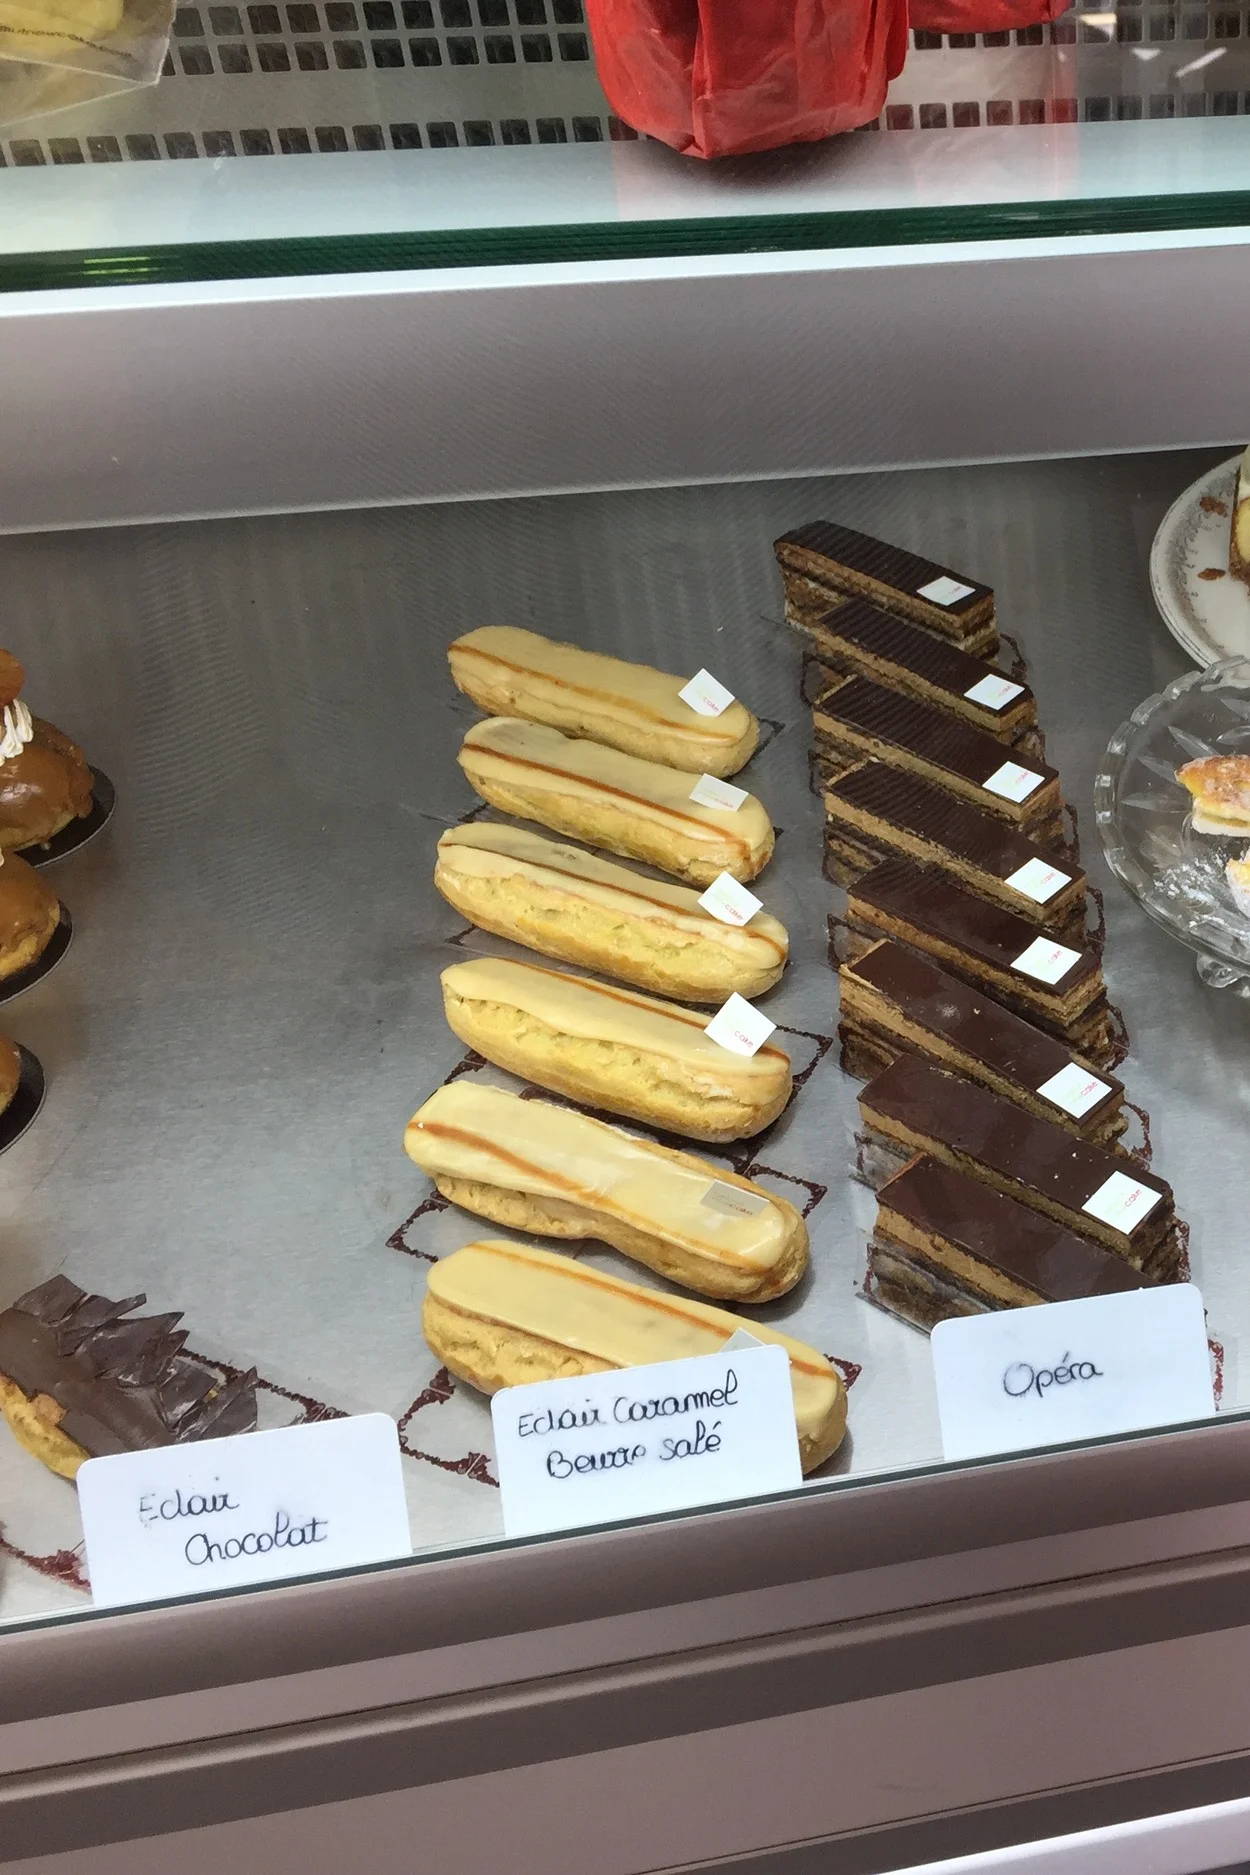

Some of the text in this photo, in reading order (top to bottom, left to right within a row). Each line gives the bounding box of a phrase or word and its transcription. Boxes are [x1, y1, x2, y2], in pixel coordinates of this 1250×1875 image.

[612, 1368, 739, 1424] Caramel
[1002, 1351, 1104, 1398] Opéra
[658, 1419, 722, 1461] salé
[184, 1510, 329, 1566] Chocolat
